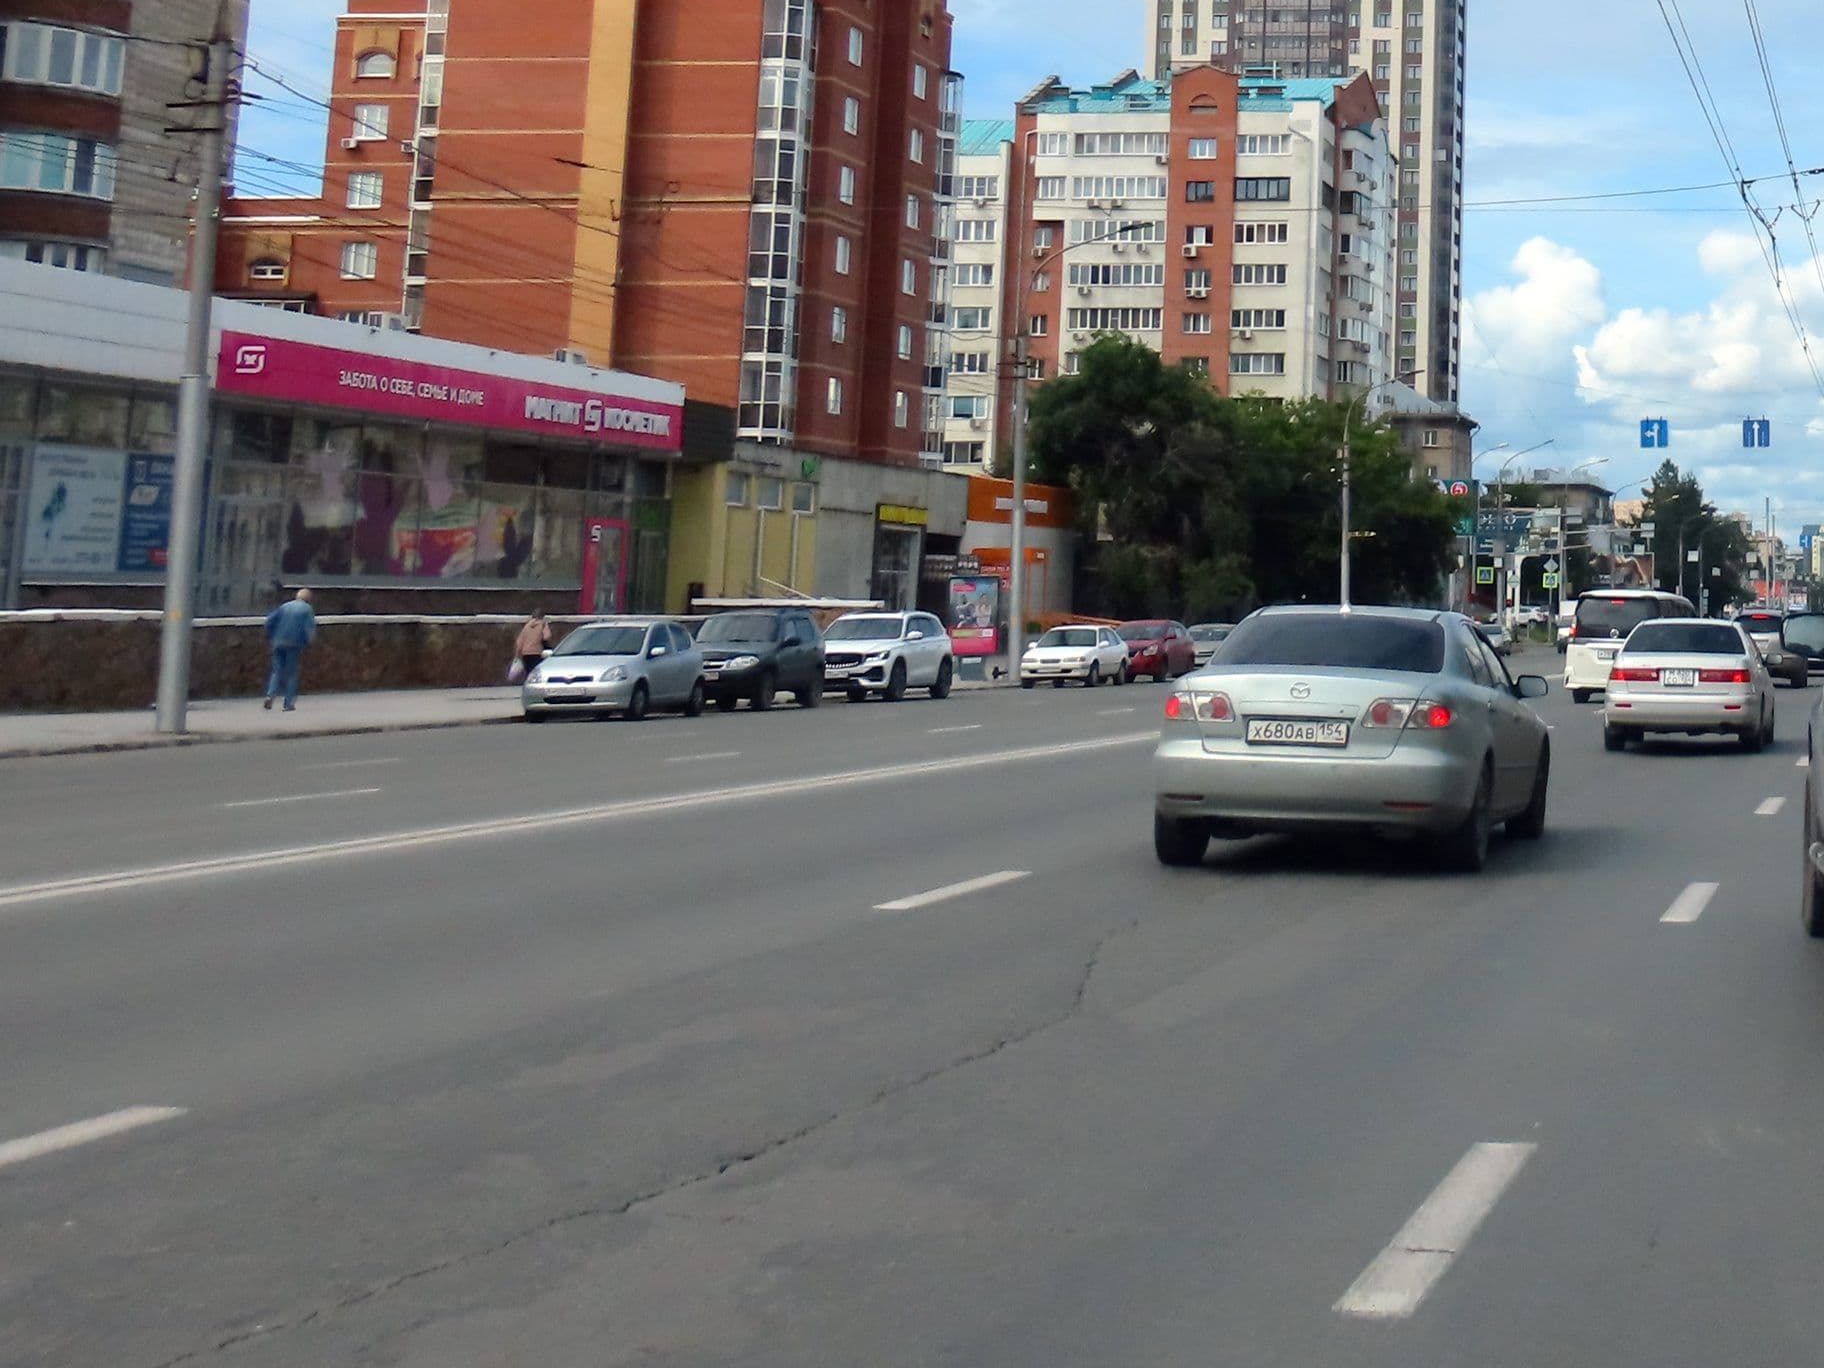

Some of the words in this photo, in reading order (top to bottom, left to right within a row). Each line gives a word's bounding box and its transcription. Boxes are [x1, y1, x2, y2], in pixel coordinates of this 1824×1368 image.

[338, 370, 379, 391] ЗАБОТА
[380, 379, 389, 392] О
[390, 380, 416, 398] СЕБЕ,
[417, 383, 448, 401] СЕМЬЕ
[458, 389, 485, 407] ДОМЕ
[1319, 723, 1342, 736] 154
